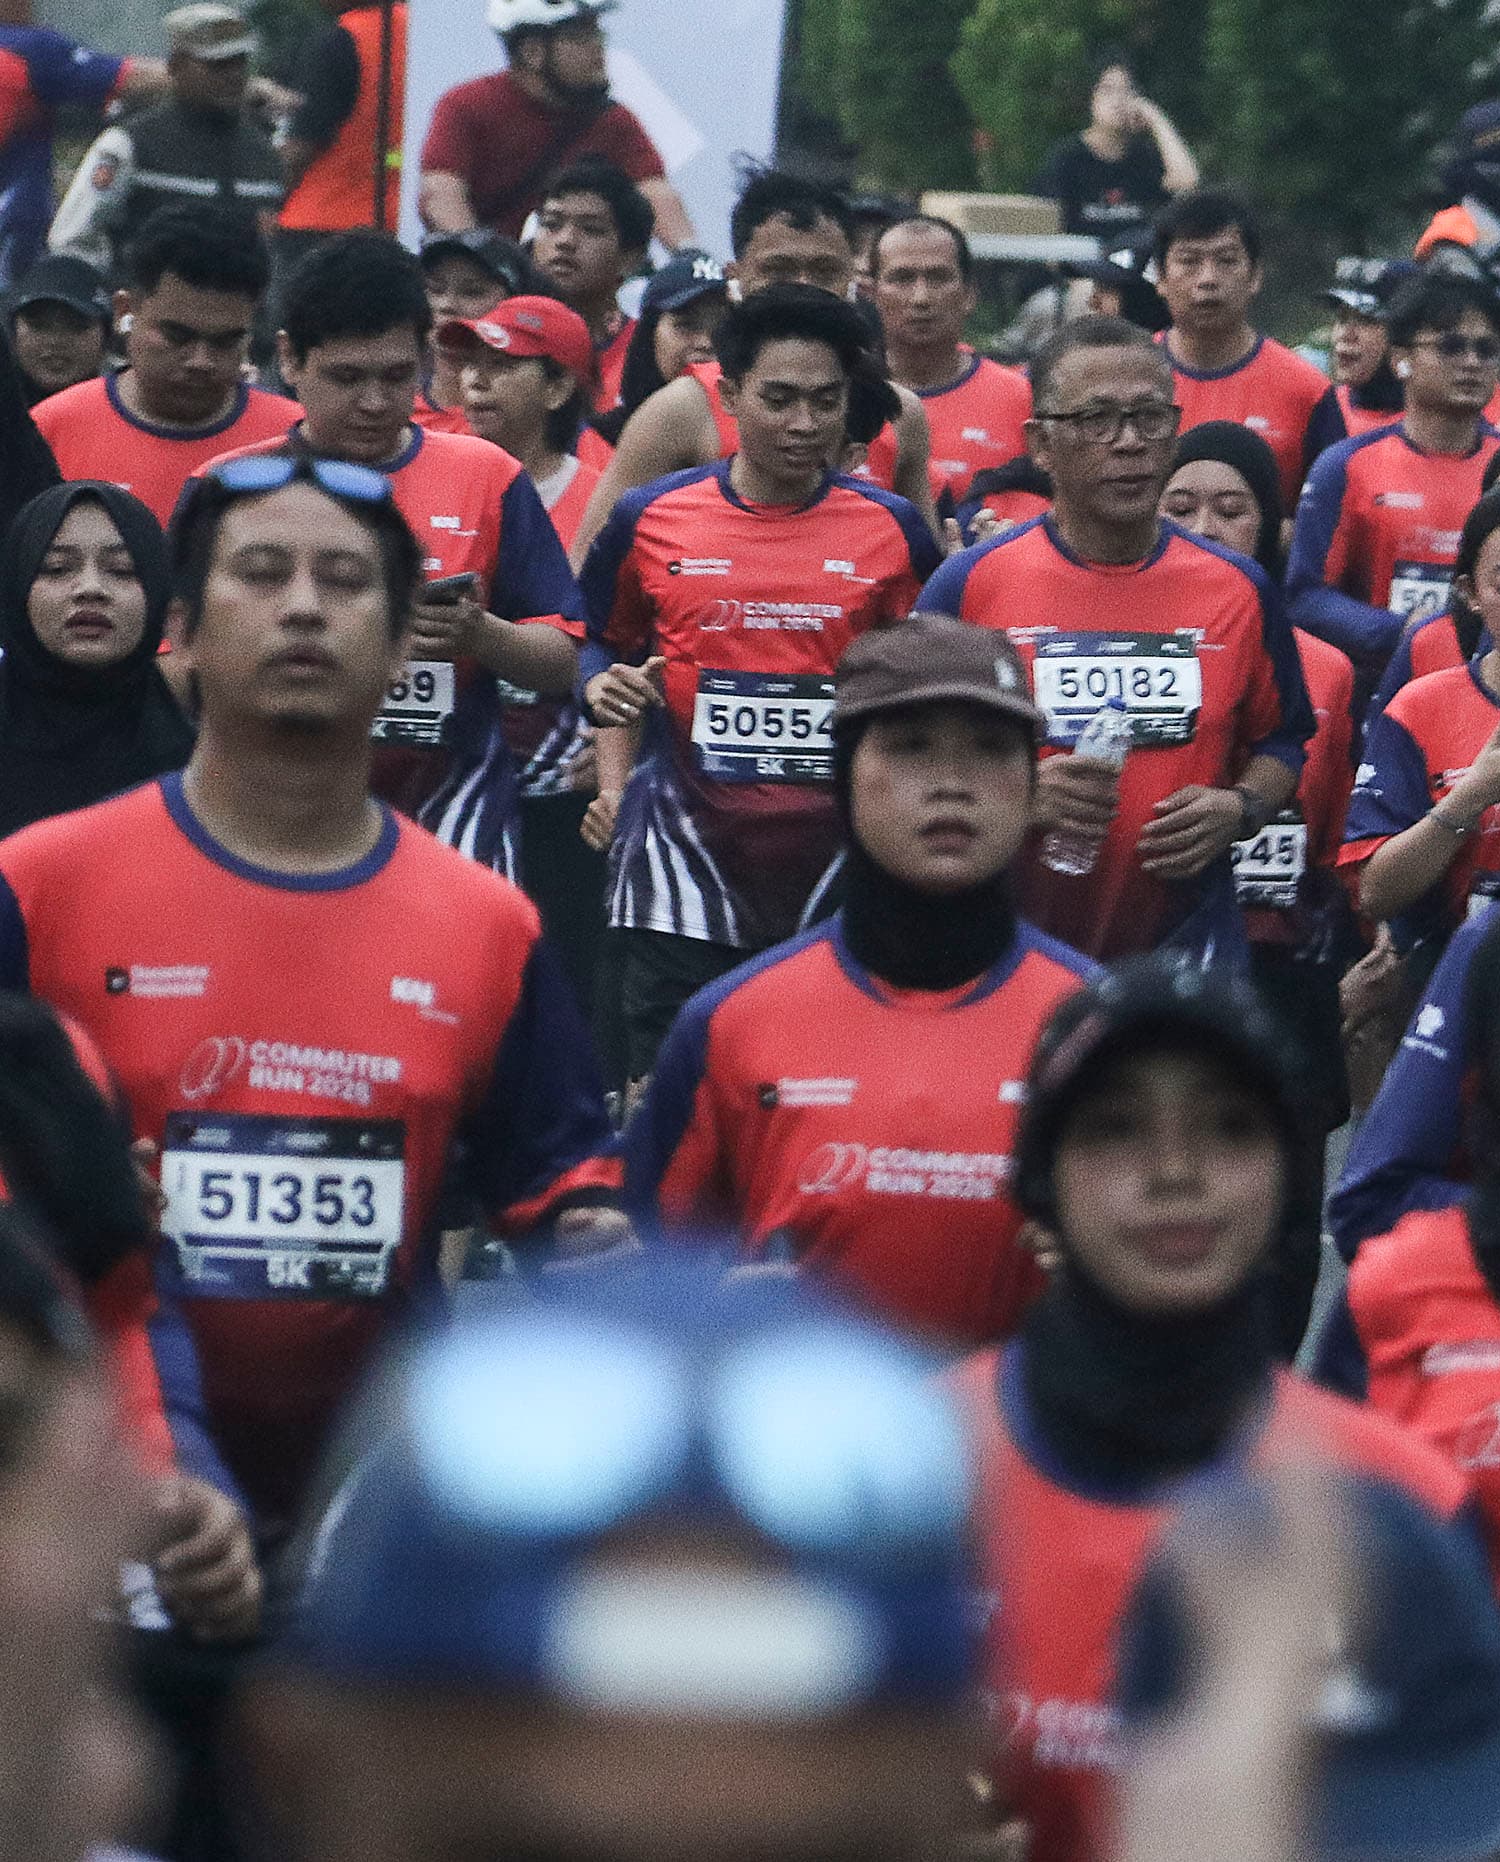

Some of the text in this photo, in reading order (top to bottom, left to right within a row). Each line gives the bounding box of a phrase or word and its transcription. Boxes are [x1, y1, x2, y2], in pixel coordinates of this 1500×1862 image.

[1059, 666, 1180, 699] 50182
[709, 703, 834, 740] 50554
[248, 1066, 306, 1093] RUN
[249, 1040, 402, 1083] COMMUTER
[199, 1169, 377, 1228] 51353
